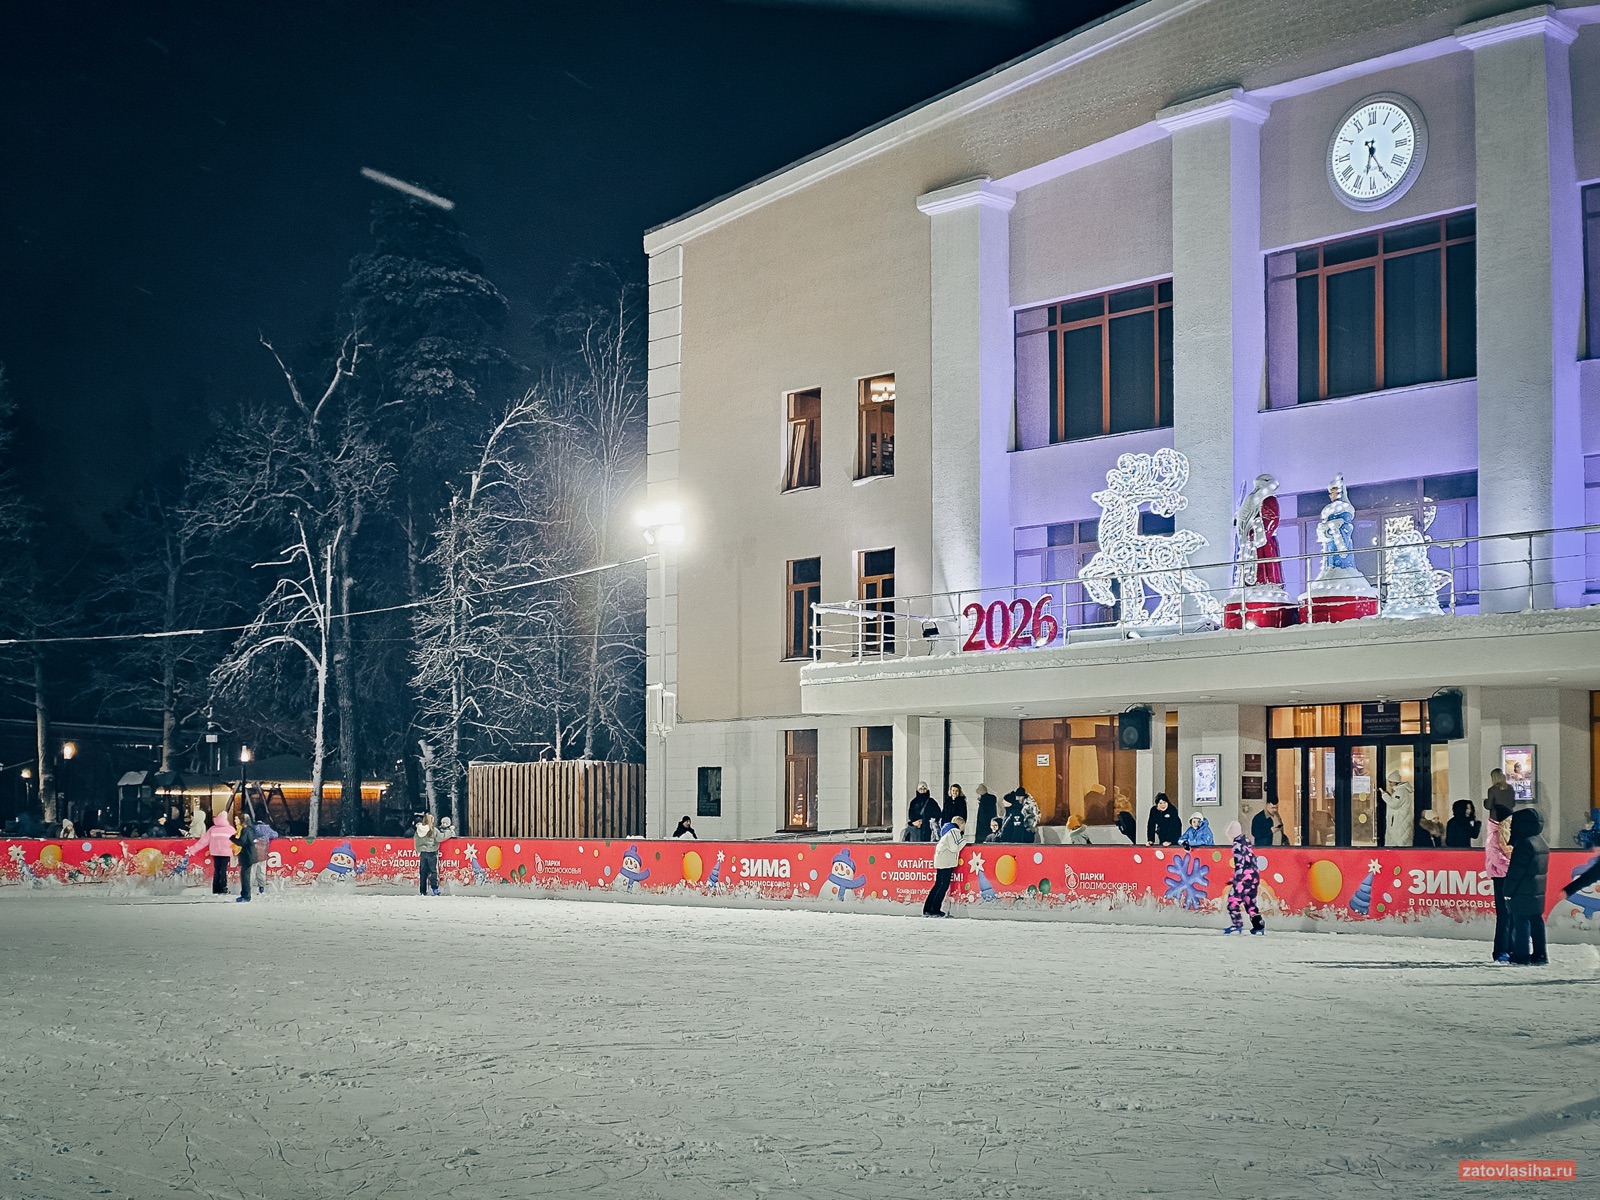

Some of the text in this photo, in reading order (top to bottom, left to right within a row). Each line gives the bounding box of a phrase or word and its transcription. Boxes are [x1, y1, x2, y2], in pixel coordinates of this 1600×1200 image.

[963, 594, 1058, 651] 2026
[397, 849, 443, 858] КАТАЬ
[381, 859, 460, 868] С УДОВОЛИЕМ!
[898, 858, 935, 869] КАТАЙТЕ
[881, 871, 887, 880] С
[1080, 882, 1138, 890] ПОДМОСКОВЬЯ
